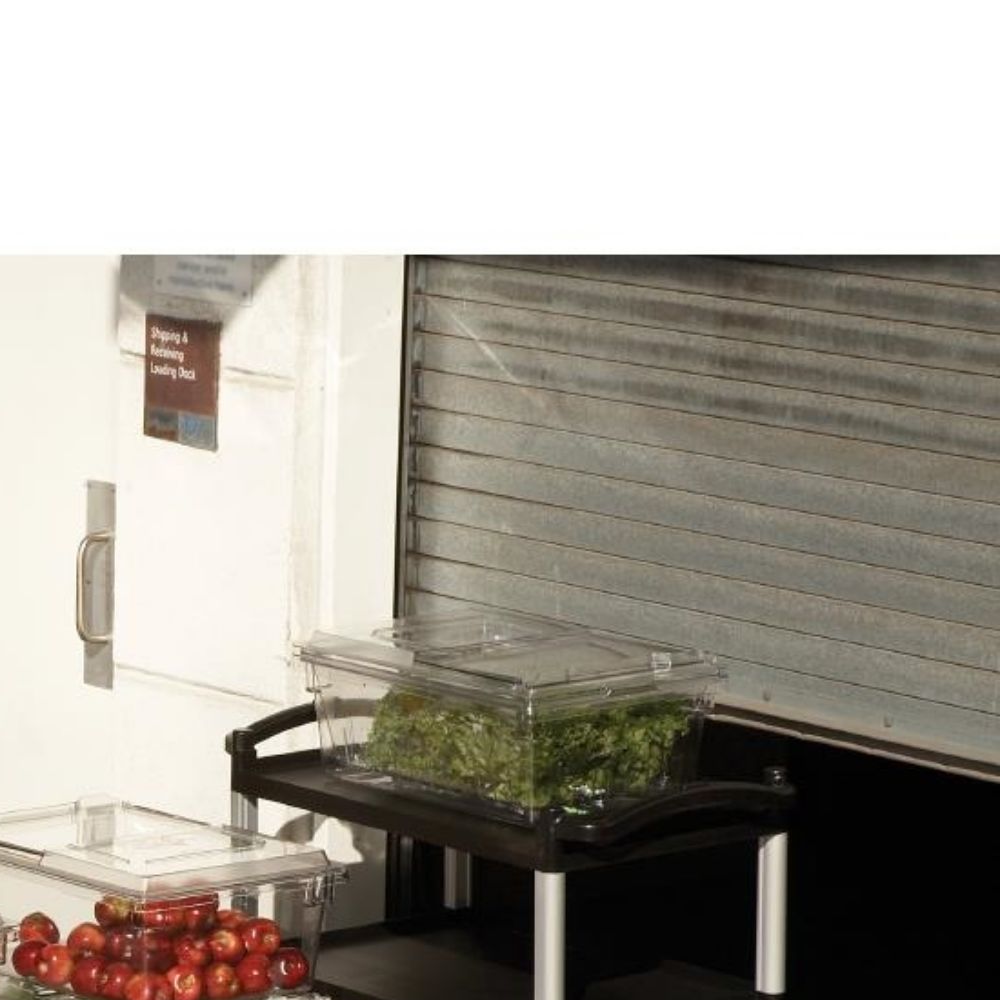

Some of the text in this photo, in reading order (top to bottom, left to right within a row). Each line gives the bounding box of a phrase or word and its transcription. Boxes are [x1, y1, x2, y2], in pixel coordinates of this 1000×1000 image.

[150, 326, 181, 345] Shipping
[150, 344, 184, 363] Receiving
[150, 361, 196, 380] Loading Dock
